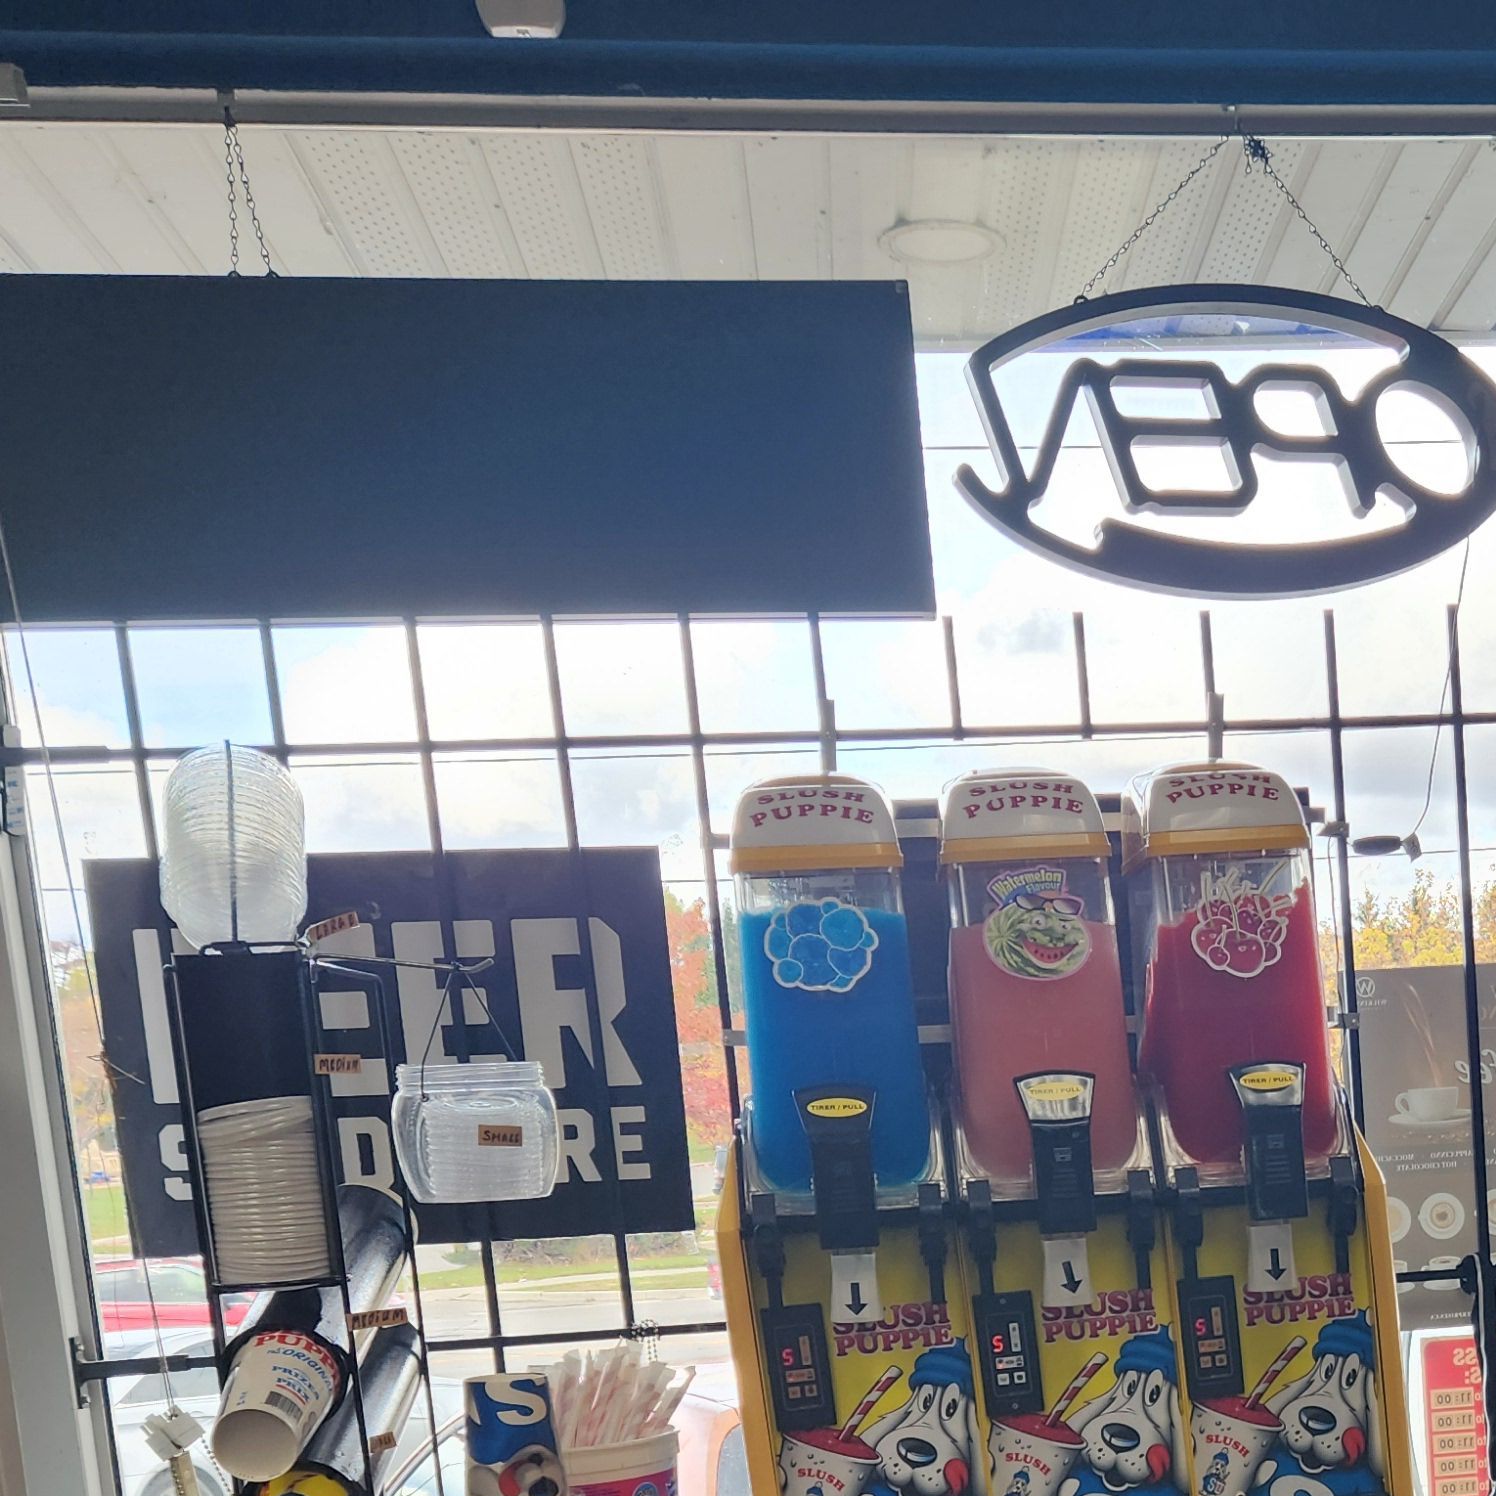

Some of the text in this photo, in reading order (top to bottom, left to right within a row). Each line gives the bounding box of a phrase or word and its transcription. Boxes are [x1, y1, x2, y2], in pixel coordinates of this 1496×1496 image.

[968, 781, 1074, 797] SLUSH
[1169, 773, 1271, 787] SLUSH
[757, 789, 865, 805] SLUSH
[1165, 783, 1279, 805] PUPPIE
[749, 803, 874, 827] PUPPIE
[962, 794, 1083, 819] PUPPIE
[990, 868, 1062, 898] Watermelon
[132, 916, 643, 1105] EER
[1243, 1296, 1356, 1327] PUPPIE
[1042, 1311, 1159, 1343] PUPPIE
[833, 1324, 954, 1357] PUPPIE
[1205, 1434, 1250, 1458] SLUSH
[1004, 1452, 1051, 1476] SLUSH
[797, 1467, 846, 1493] SLUSH
